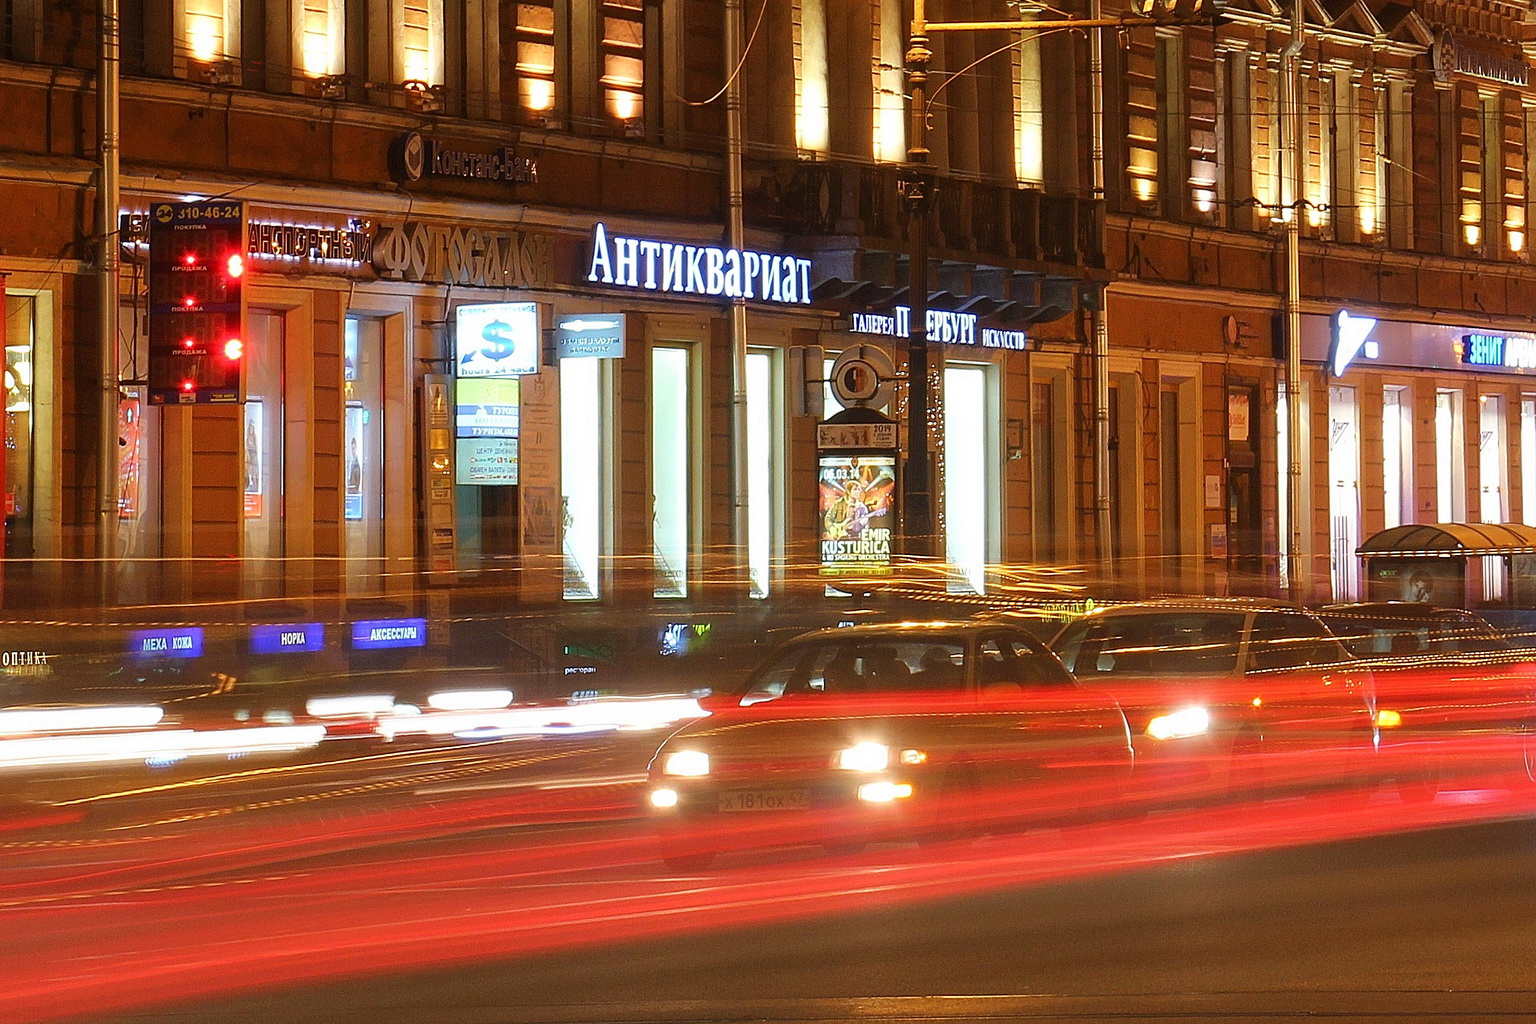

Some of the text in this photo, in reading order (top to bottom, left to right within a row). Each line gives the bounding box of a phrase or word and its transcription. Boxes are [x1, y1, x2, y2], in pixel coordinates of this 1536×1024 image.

[431, 139, 539, 183] Констанс-Банк
[177, 206, 240, 219] 310-46-24
[248, 221, 372, 264] АНСПОРТНЫЙ
[382, 223, 556, 288] ФОТОСАЛОН
[851, 313, 895, 335] ГАЛЕРЕЯ
[895, 306, 977, 345] ПЕРБУРГ
[1469, 334, 1502, 366] ЗЕНИТ
[862, 528, 891, 541] EMIR
[821, 540, 891, 554] KUSTURICA
[142, 636, 193, 651] МЕХА КОЖА
[281, 631, 306, 646] НОРКА
[2, 651, 47, 667] ОПТИКА
